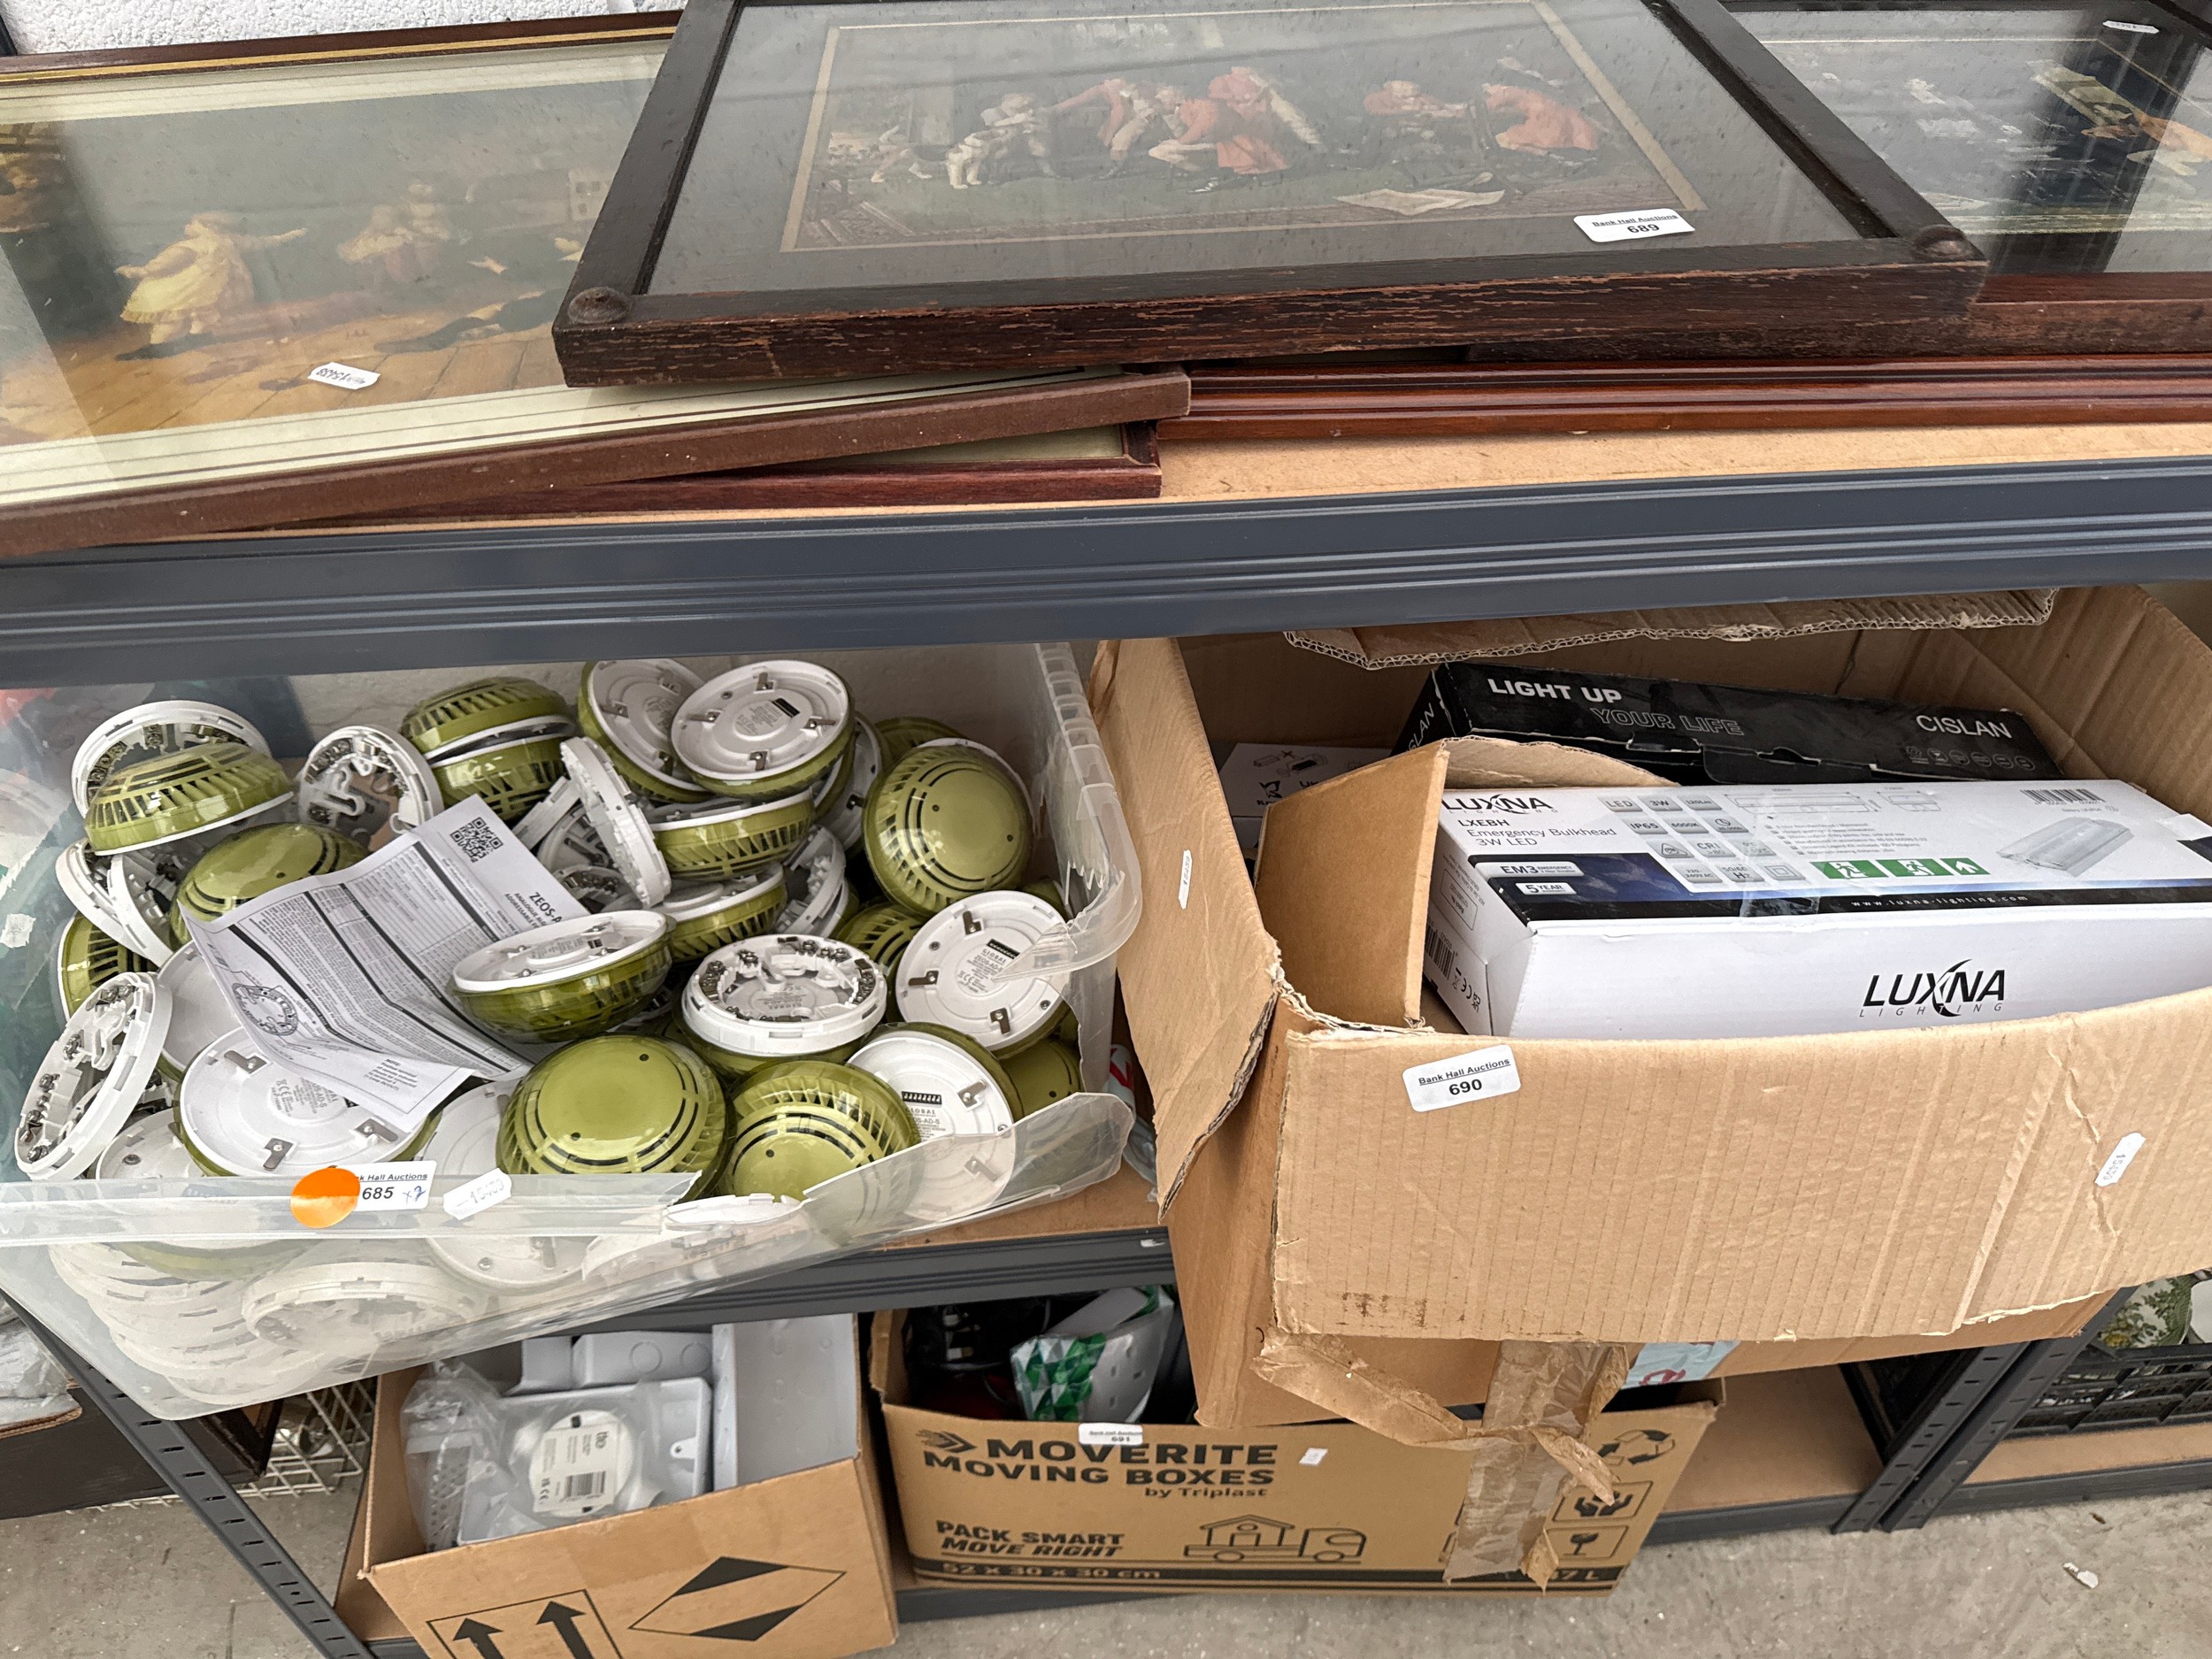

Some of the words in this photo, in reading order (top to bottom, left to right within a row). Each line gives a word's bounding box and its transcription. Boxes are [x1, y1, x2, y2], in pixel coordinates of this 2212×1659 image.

[1627, 224, 1660, 234] 689
[1486, 678, 1572, 701] LIGHT
[1581, 686, 1623, 704] UP
[1589, 707, 1675, 729] YOUR
[1679, 714, 1746, 736] LIFE
[1916, 715, 2013, 739] CISLAN
[1442, 794, 1553, 812] LUXNA
[1467, 829, 1546, 838] Emergency
[1550, 827, 1617, 837] Bulkhead
[1500, 865, 1539, 874] EM3
[1525, 884, 1540, 894] 5
[1851, 895, 2028, 907] www.luxna-lighting.com
[1863, 966, 2006, 1010] LUXNA
[1859, 1002, 2002, 1018] LIGHTING
[1418, 1073, 1443, 1086] Bank
[1445, 1069, 1464, 1079] Hall
[1467, 1058, 1510, 1074] Auctions
[1448, 1079, 1483, 1095] 690
[362, 1187, 395, 1200] 685
[987, 1438, 1279, 1465] MOVERITE
[923, 1449, 1110, 1485] MOVING
[1125, 1469, 1276, 1486] BOXES
[1145, 1487, 1171, 1499] by
[1179, 1487, 1269, 1499] Triplast
[936, 1520, 1011, 1543] PACK
[1021, 1532, 1125, 1546] SMART
[941, 1537, 1025, 1555] MOVE
[1032, 1546, 1124, 1557] RIGHT
[942, 1563, 977, 1575] 52
[984, 1566, 1002, 1576] x
[1010, 1566, 1042, 1577] 30
[1051, 1568, 1068, 1577] x
[1076, 1568, 1110, 1578] 30
[1117, 1570, 1161, 1578] cm
